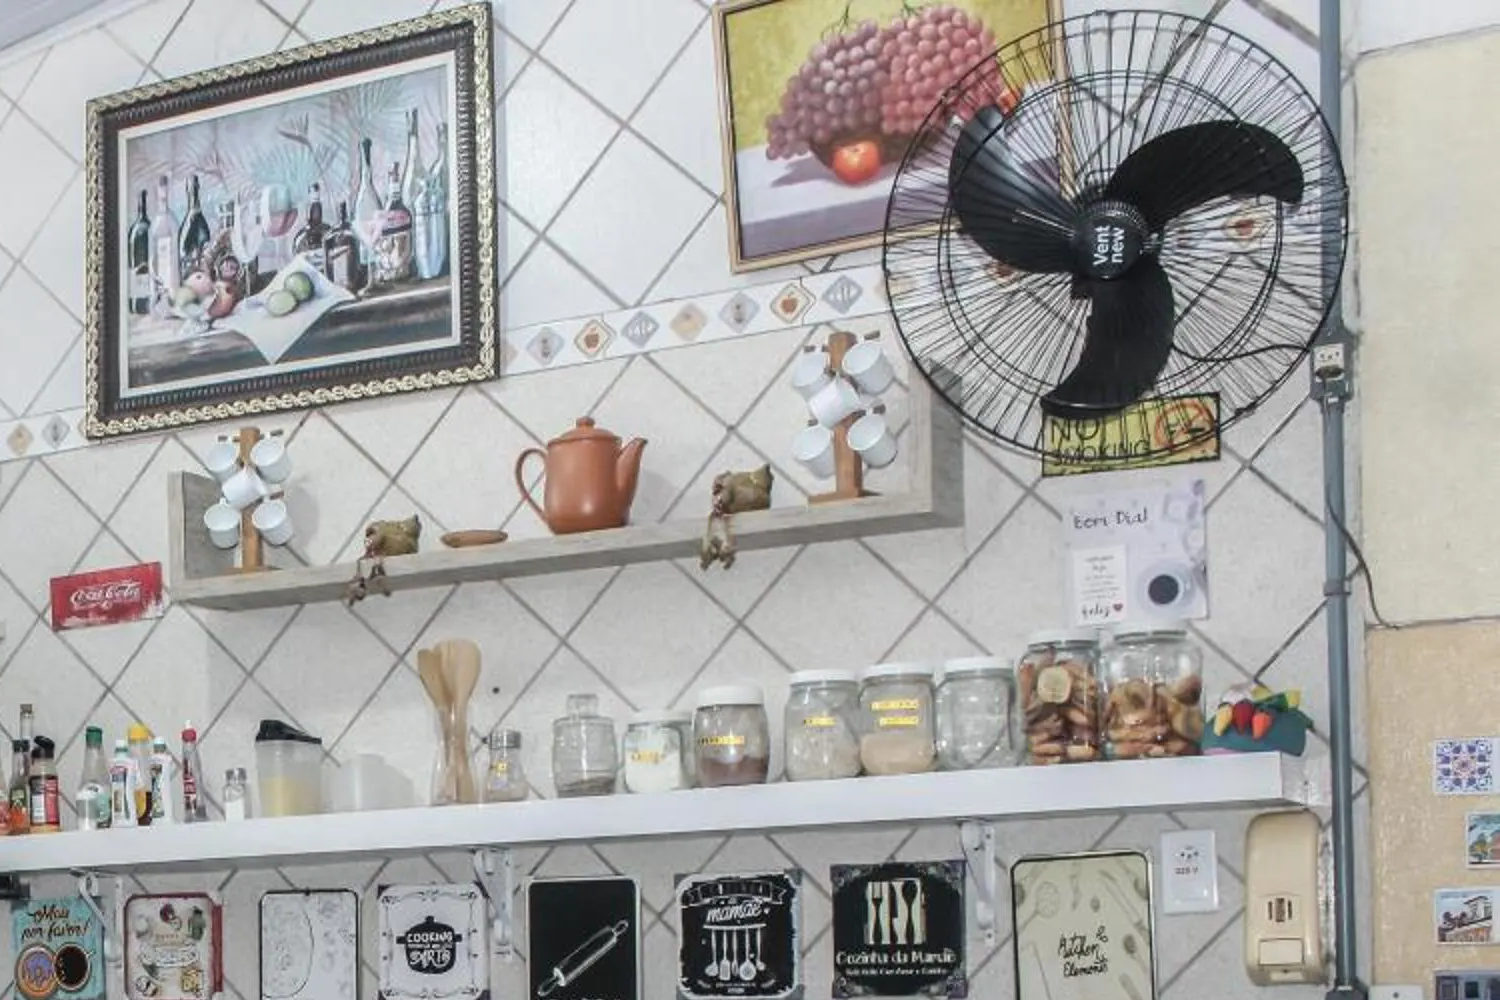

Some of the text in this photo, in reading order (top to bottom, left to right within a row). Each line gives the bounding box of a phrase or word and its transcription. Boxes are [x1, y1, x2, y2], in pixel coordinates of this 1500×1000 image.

[1092, 225, 1111, 266] Vent
[1111, 227, 1125, 263] new
[1051, 417, 1100, 444] NO
[406, 931, 453, 943] COOKING
[835, 950, 889, 965] Cozinha
[891, 950, 909, 963] da
